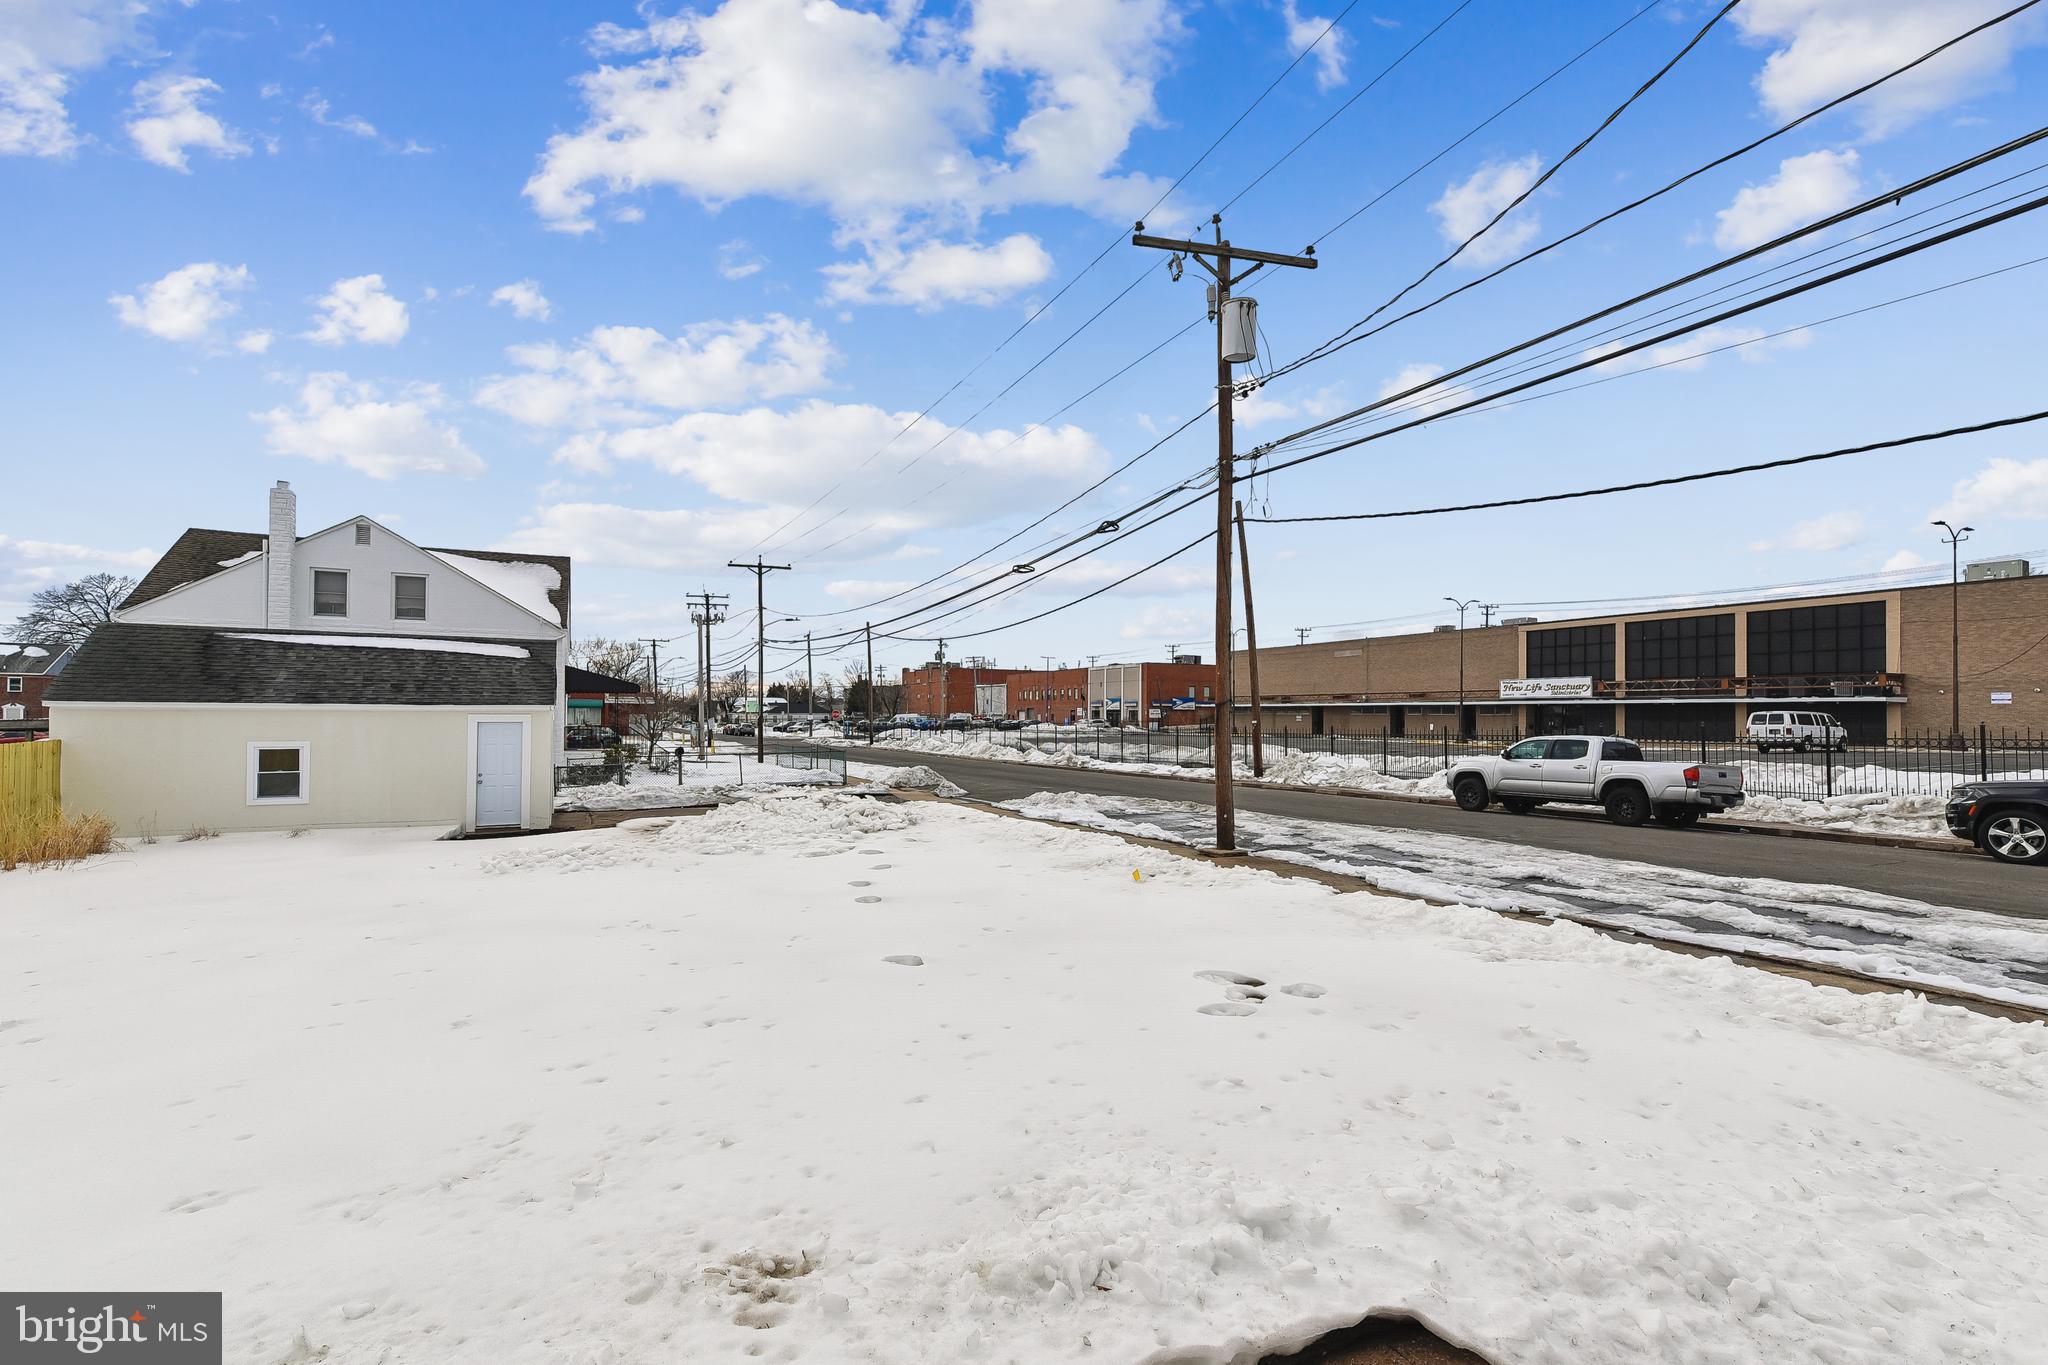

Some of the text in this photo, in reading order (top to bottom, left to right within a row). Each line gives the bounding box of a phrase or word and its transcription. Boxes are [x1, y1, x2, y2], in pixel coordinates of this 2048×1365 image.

[1503, 683, 1591, 693] New Life Sanctuary
